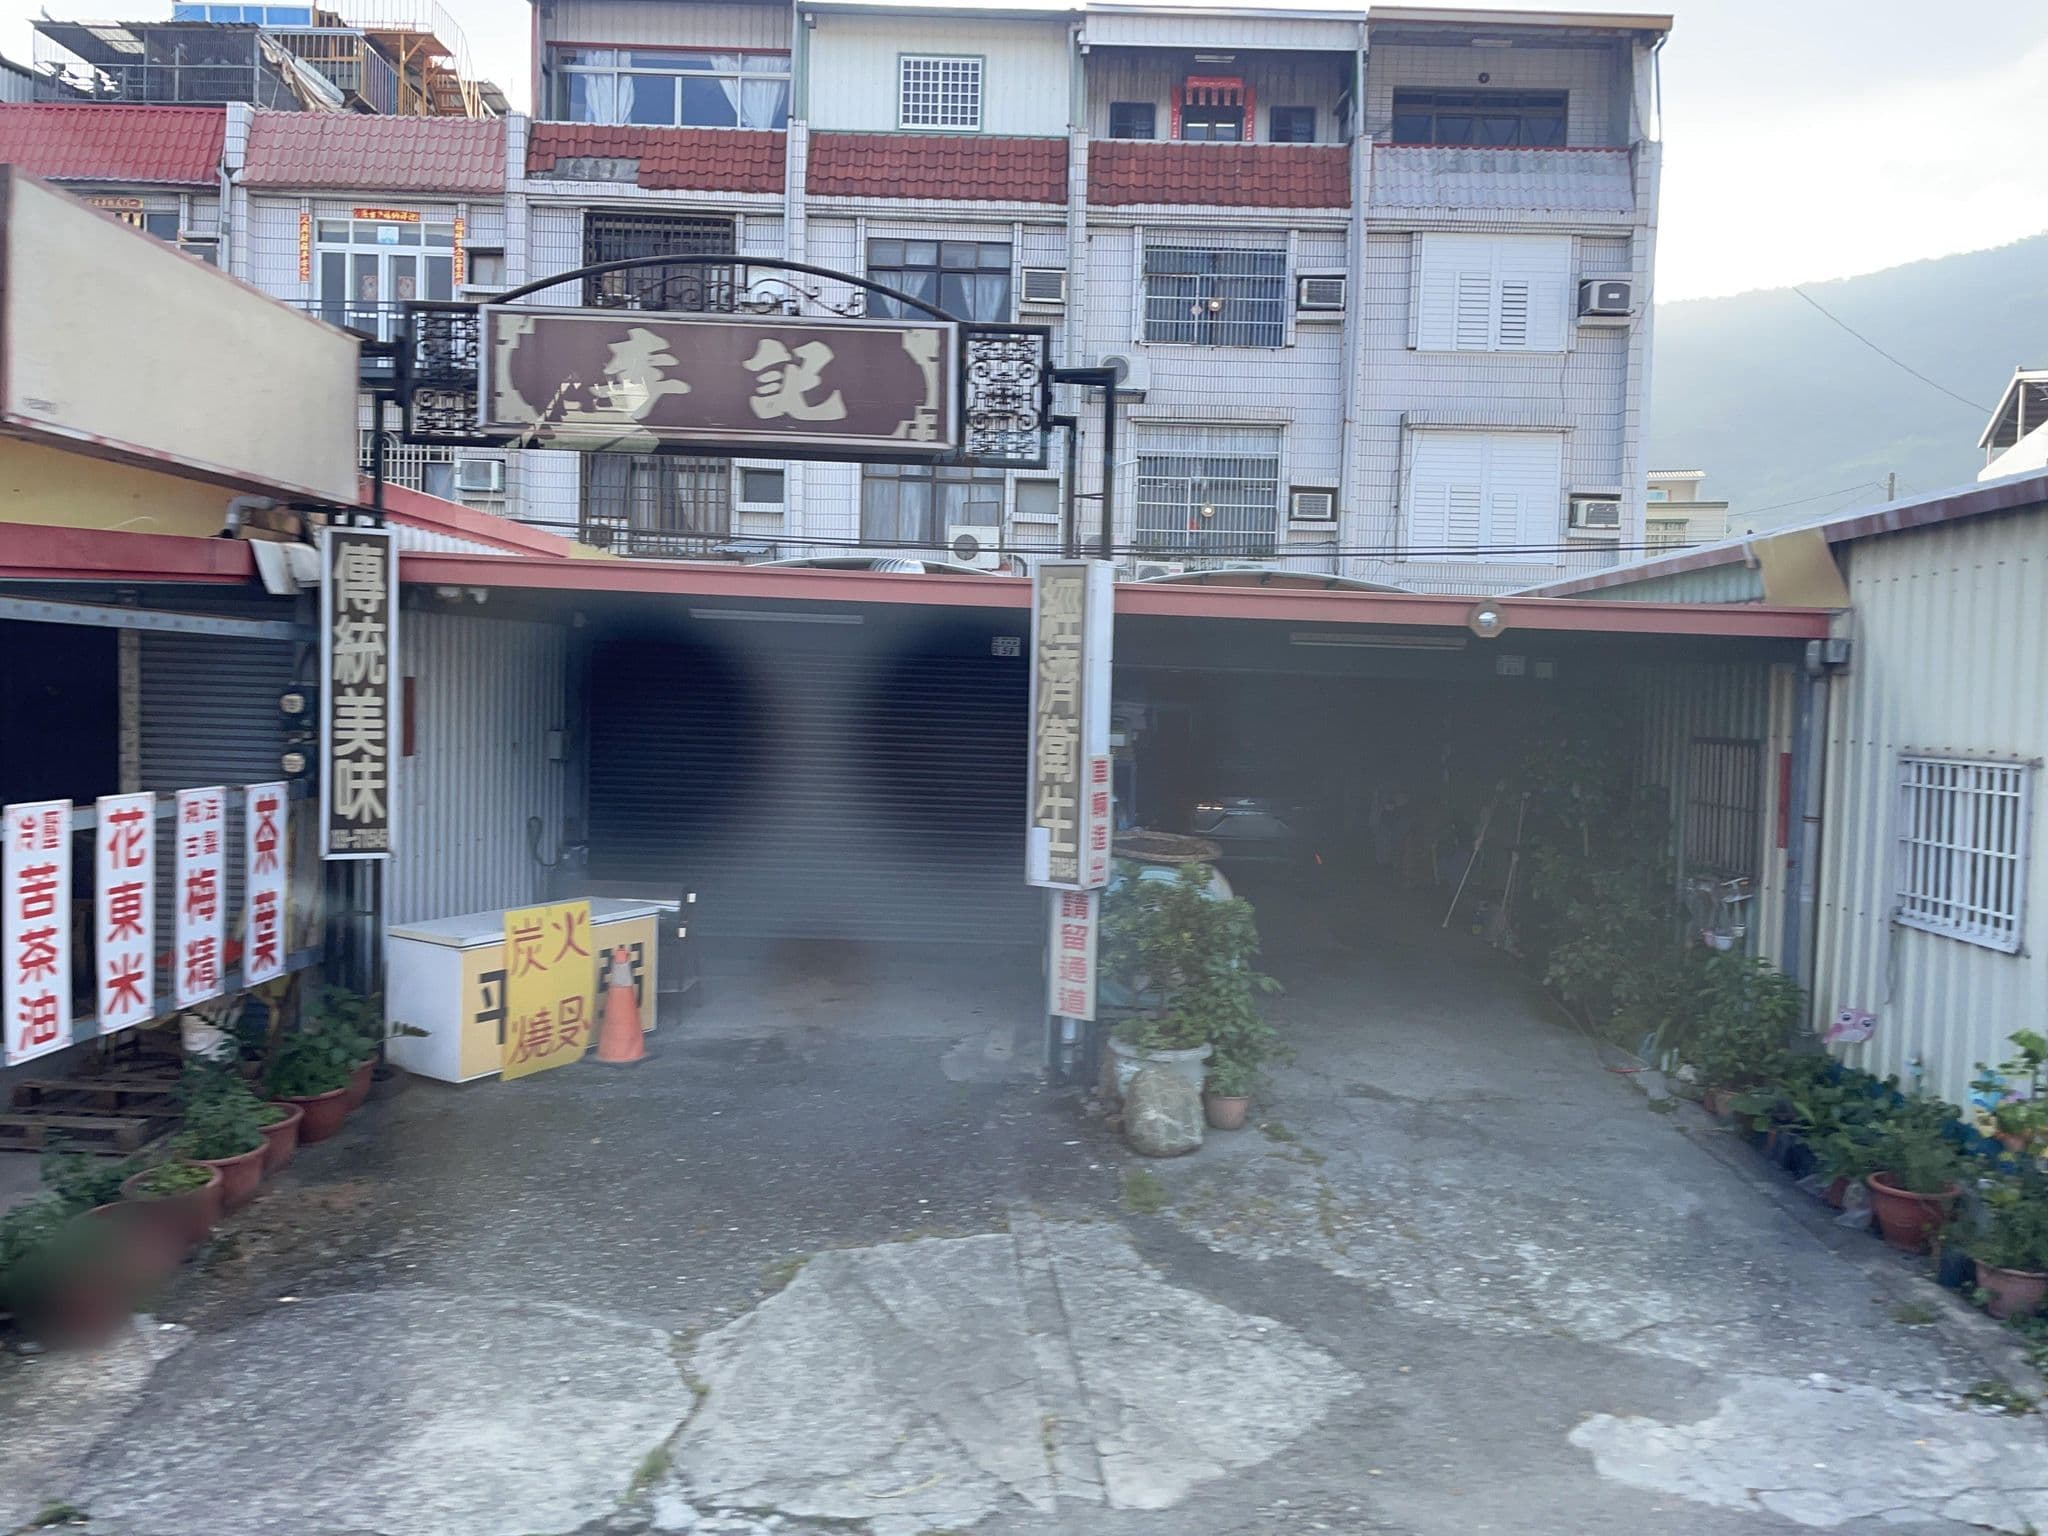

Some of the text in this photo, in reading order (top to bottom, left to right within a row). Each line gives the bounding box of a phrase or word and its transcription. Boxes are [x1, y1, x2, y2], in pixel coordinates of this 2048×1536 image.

[333, 541, 386, 824] 傳統美味
[1036, 576, 1082, 854] 經濟衛生
[17, 863, 59, 1051] 苦茶油
[105, 806, 145, 1015] 花東米
[186, 869, 217, 994] 梅精
[252, 792, 280, 972] 茶葉
[510, 910, 592, 977] 炭火
[1058, 891, 1089, 1015] 請留通道
